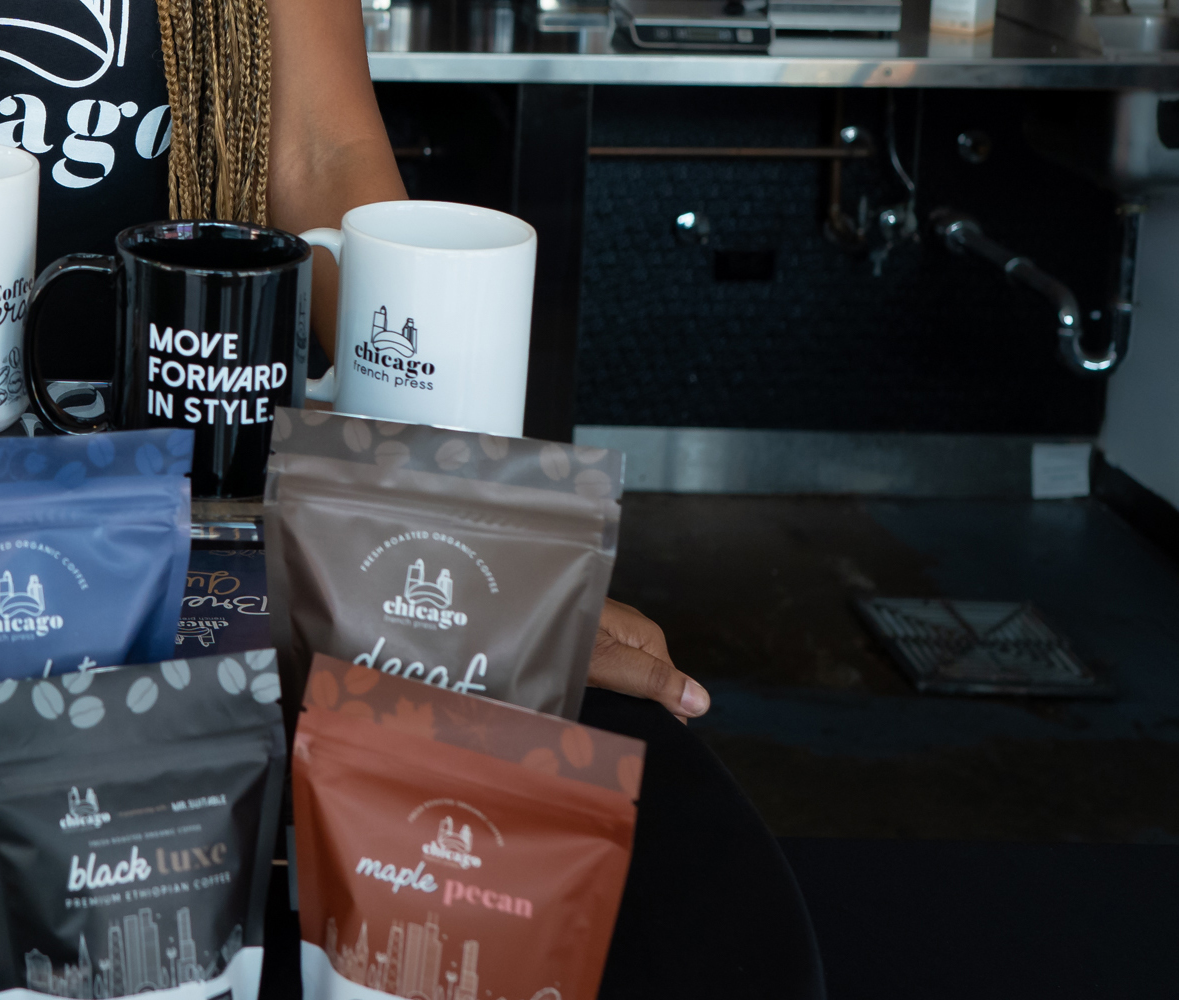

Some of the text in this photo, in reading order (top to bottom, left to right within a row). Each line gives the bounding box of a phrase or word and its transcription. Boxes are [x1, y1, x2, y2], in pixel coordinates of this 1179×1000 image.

[149, 323, 238, 359] MOVE
[148, 357, 287, 393] FORWARD
[353, 359, 434, 391] french press
[354, 341, 436, 379] chicago
[148, 388, 274, 425] IN STYLE.
[15, 539, 61, 560] ORGANIC
[61, 557, 89, 591] COFFEE
[360, 530, 500, 594] FRESH ROASTED ORGANIC COFFEE
[181, 595, 270, 615] Bre
[382, 595, 468, 630] chicago
[59, 812, 111, 829] chicago
[67, 842, 227, 892] black luxe
[422, 840, 482, 870] chicago
[64, 871, 231, 909] PREMIUM ETHIOPIAN COFFEE
[355, 856, 533, 919] maple pecan
